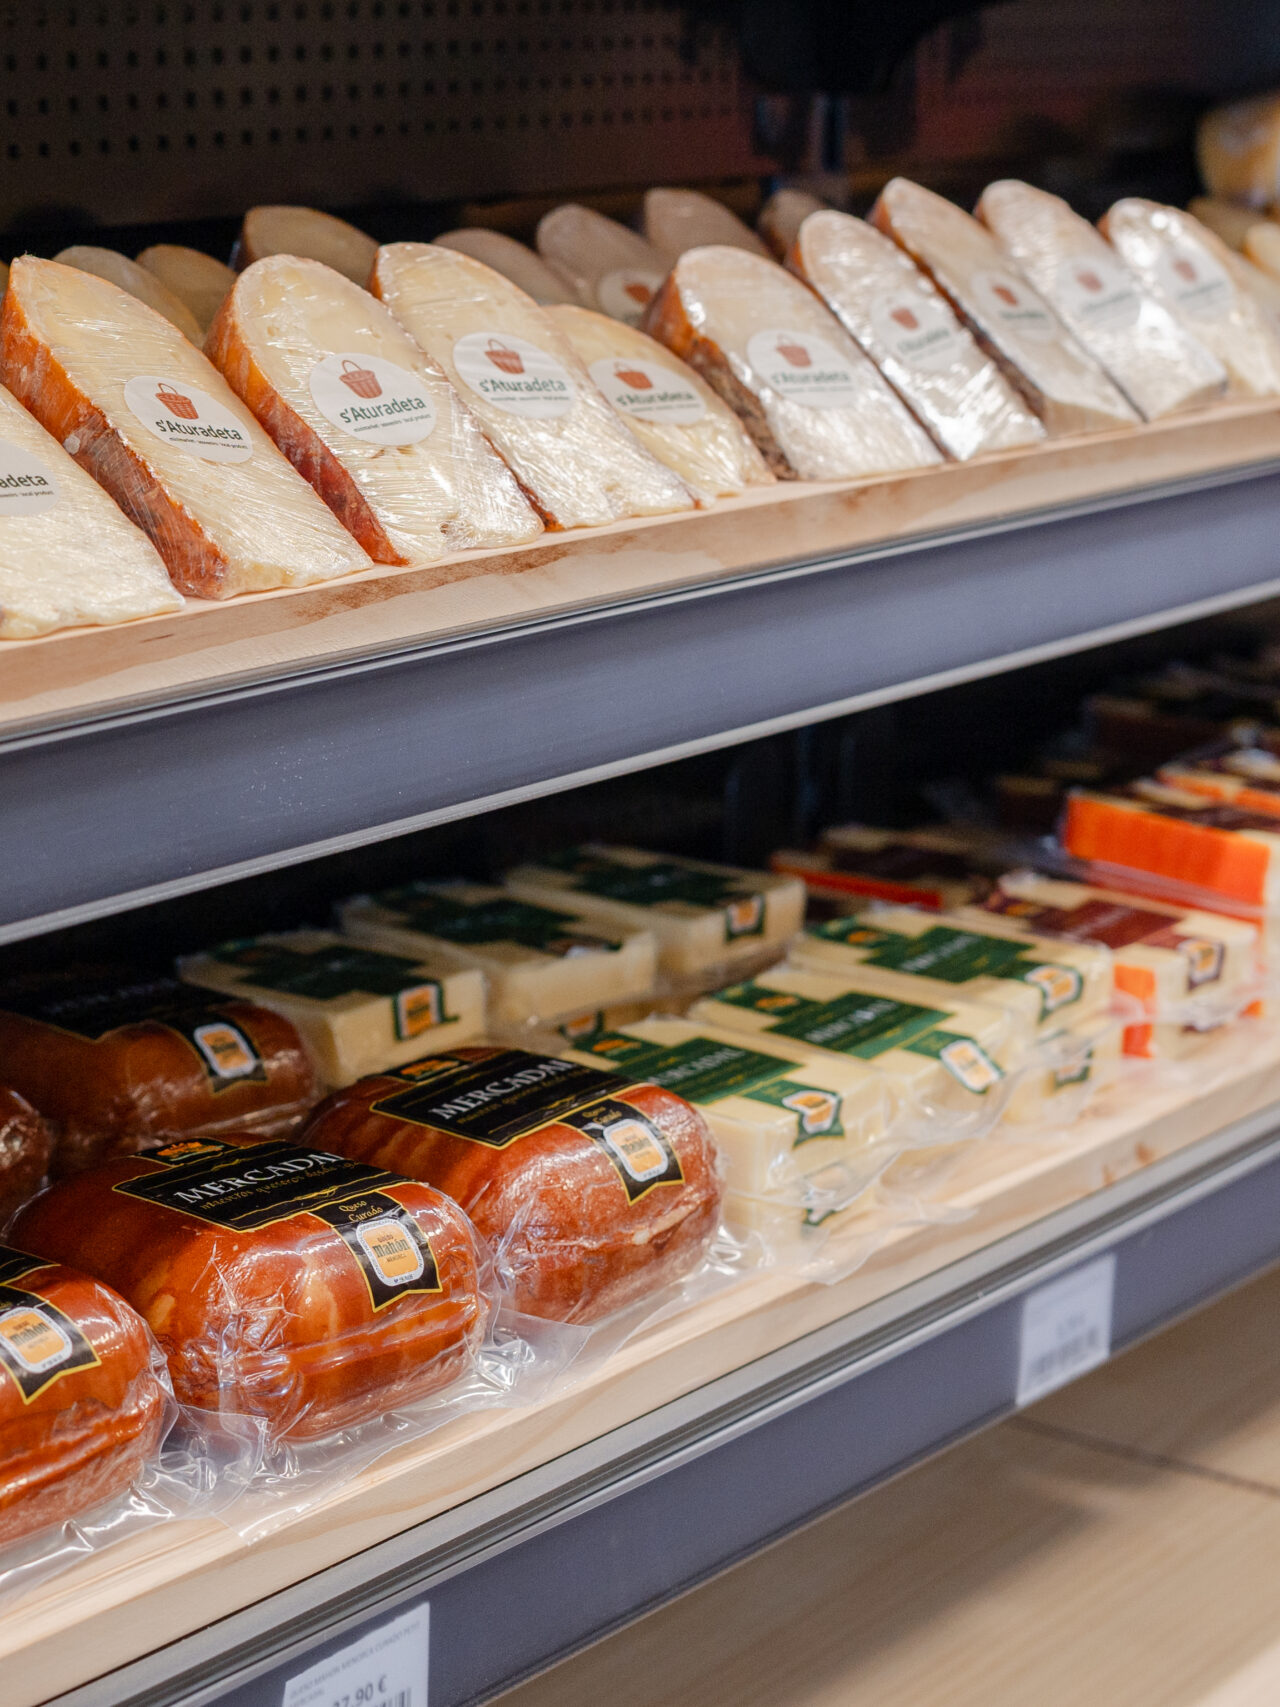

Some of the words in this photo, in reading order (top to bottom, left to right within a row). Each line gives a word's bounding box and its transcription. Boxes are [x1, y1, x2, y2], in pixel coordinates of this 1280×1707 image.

[479, 378, 568, 393] s'Aturadeta
[339, 398, 427, 423] s'Aturadeta
[155, 419, 243, 441] s'Aturadeta
[428, 1058, 578, 1120] MERCADAL
[173, 1151, 346, 1204] MERCADAL
[338, 1200, 368, 1213] Queso
[347, 1205, 384, 1223] Curado
[372, 1238, 411, 1258] Mahón
[332, 1682, 374, 1707] 790
